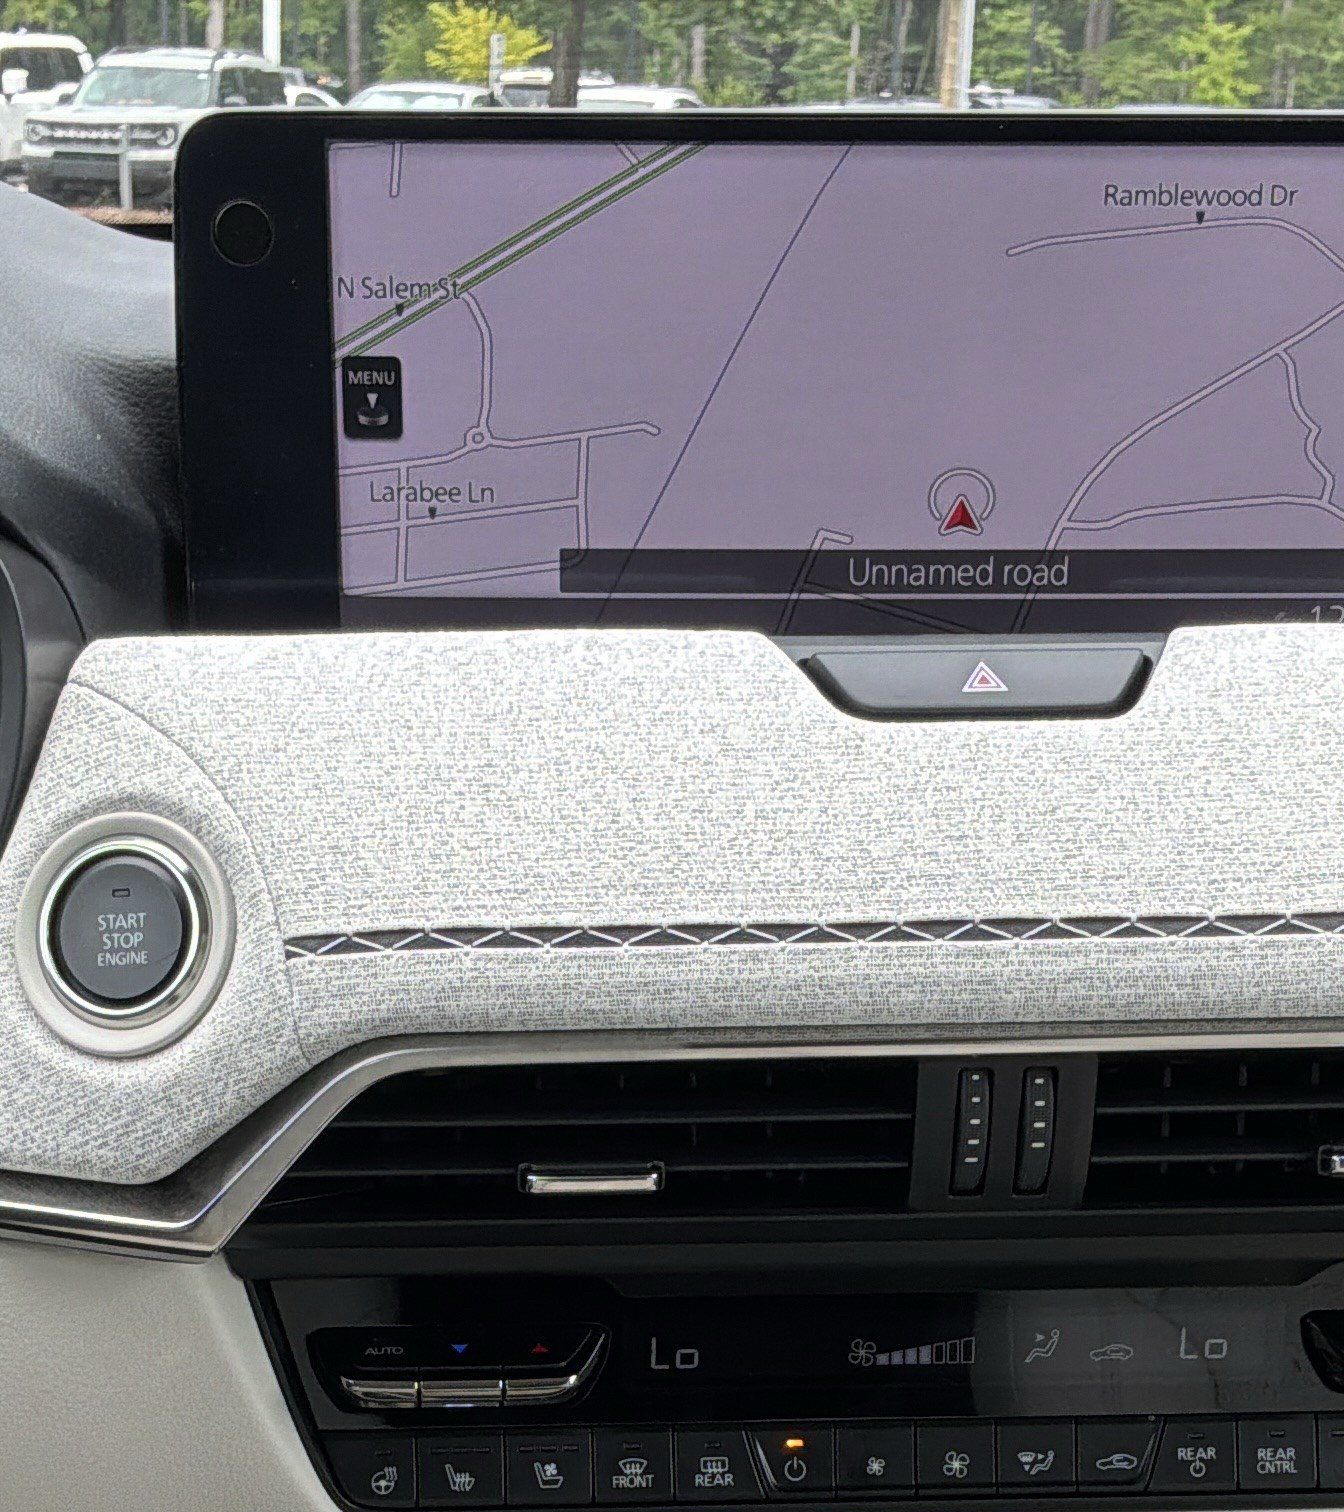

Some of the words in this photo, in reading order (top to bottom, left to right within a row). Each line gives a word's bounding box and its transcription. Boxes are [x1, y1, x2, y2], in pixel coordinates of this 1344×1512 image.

[1103, 183, 1264, 207] Ramblewood
[1270, 183, 1299, 207] Dr
[337, 276, 355, 299] N
[360, 275, 432, 300] Salem
[437, 277, 461, 300] St
[347, 370, 396, 386] MENU
[369, 480, 462, 503] Larabee
[468, 481, 495, 503] Ln
[849, 555, 994, 587] Unnamed
[1002, 555, 1069, 587] road
[97, 912, 147, 931] START
[102, 932, 144, 950] STOP
[97, 950, 149, 967] ENGINE
[364, 1346, 404, 1356] AUTO
[1177, 1446, 1217, 1461] REAR
[1257, 1446, 1297, 1461] REAR
[1256, 1460, 1298, 1475] CNTRL
[612, 1474, 655, 1489] FRONT
[694, 1473, 735, 1488] REAR
